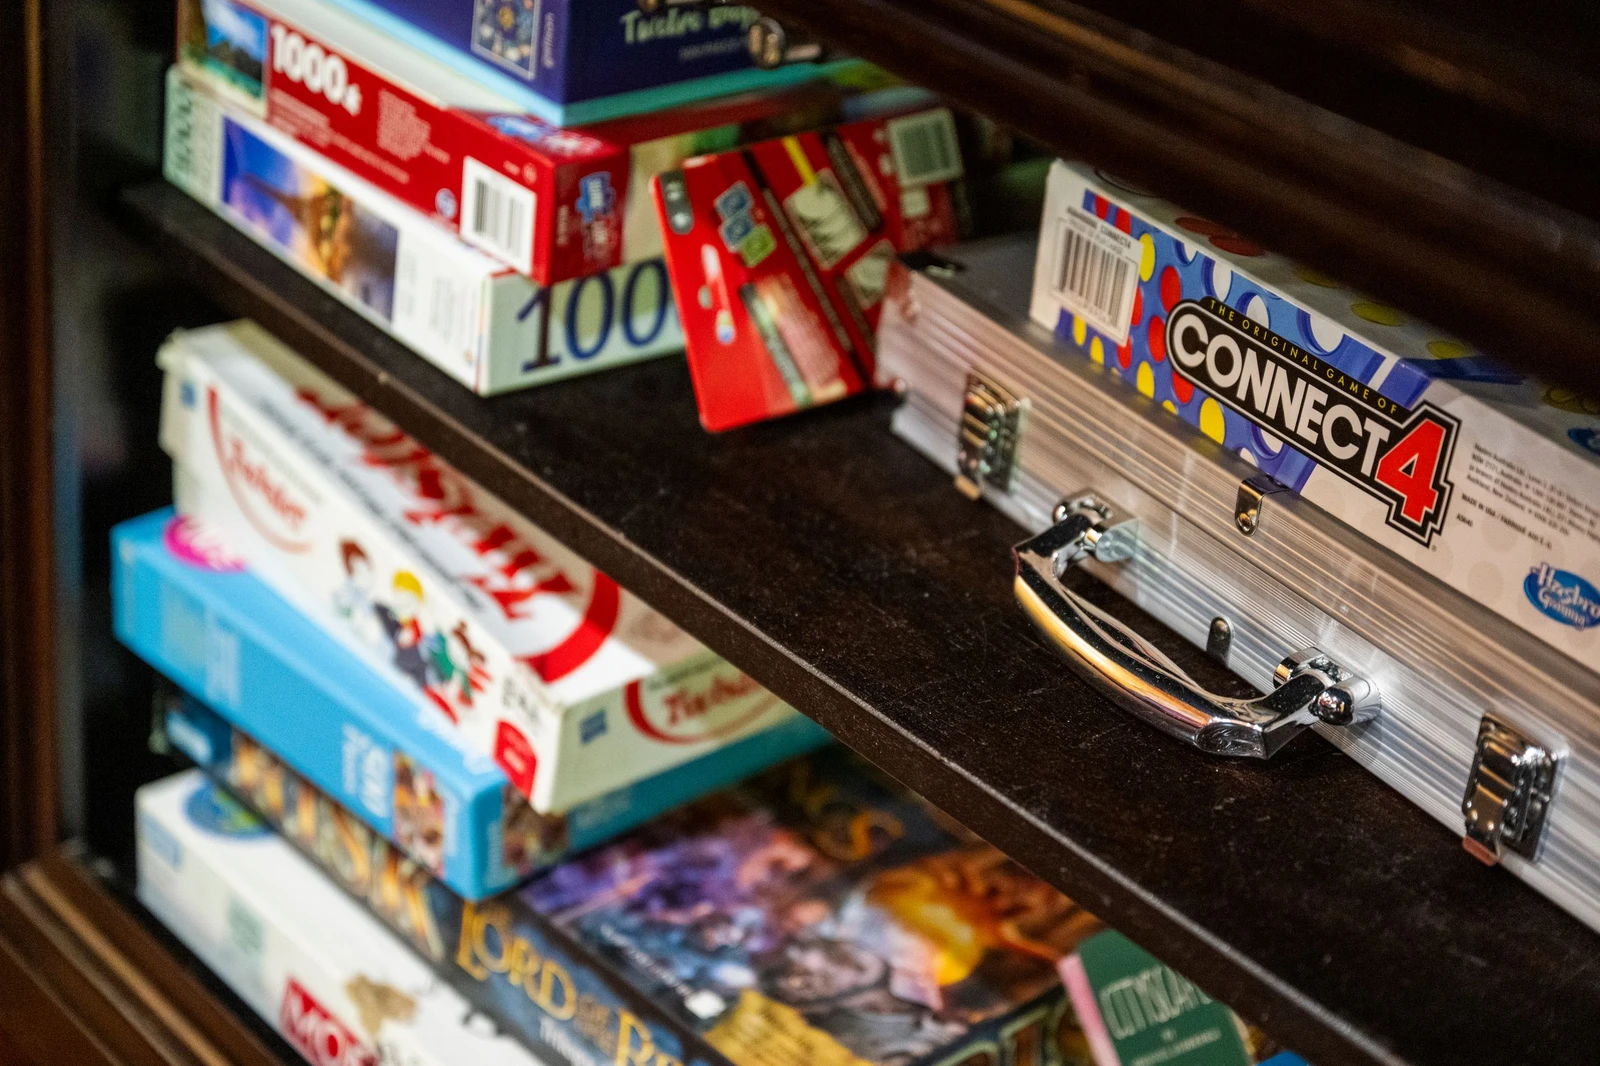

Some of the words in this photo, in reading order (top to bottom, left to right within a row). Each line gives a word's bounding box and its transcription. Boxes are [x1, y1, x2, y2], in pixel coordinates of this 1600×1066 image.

[270, 24, 348, 106] 1000
[1209, 299, 1235, 322] THE
[1242, 318, 1319, 371] ORIGINAL
[1325, 368, 1370, 400] GAME
[1377, 397, 1399, 415] OF
[1173, 313, 1391, 478] CONNECT
[1375, 417, 1447, 525] 4
[1530, 560, 1600, 617] Hasbro
[1538, 587, 1587, 632] Gaming
[456, 900, 578, 1021] LORD
